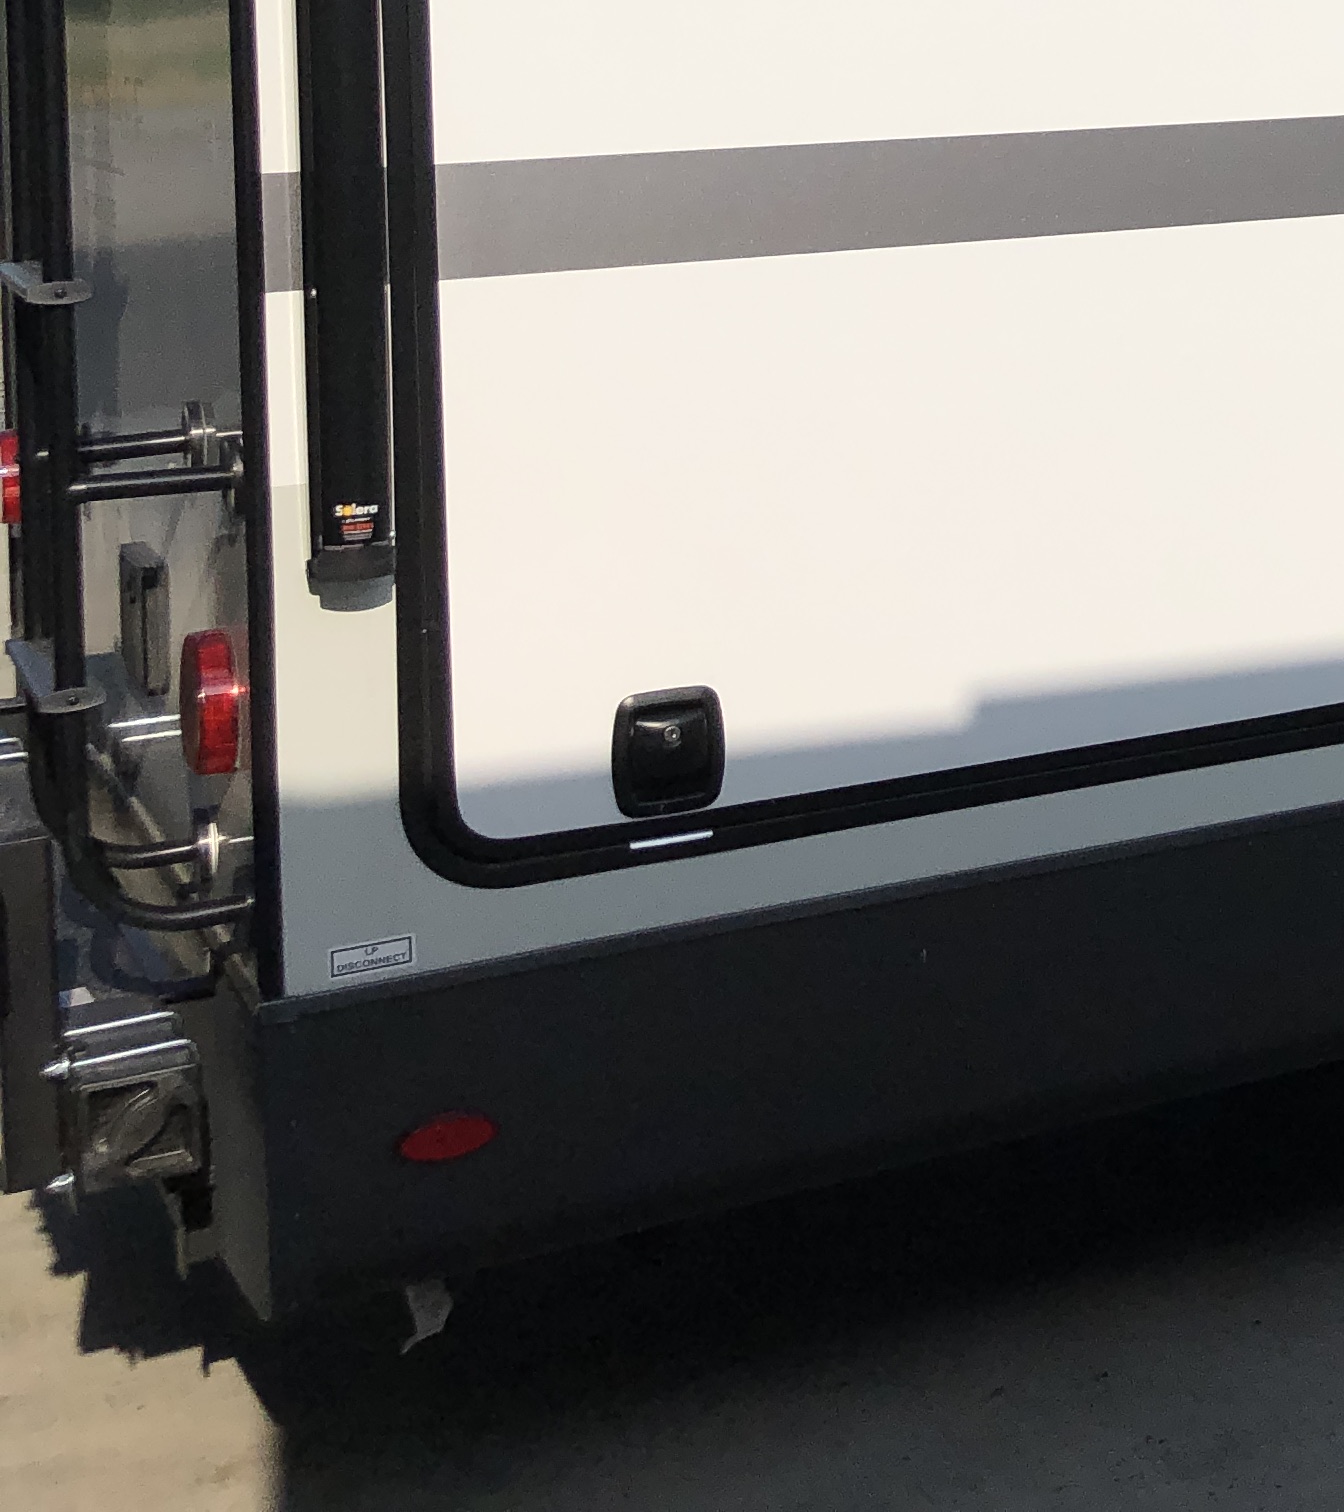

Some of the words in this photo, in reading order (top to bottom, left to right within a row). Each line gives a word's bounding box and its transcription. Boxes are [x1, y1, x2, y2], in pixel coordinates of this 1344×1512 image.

[334, 502, 380, 517] Solera
[364, 946, 379, 956] LP
[336, 951, 407, 973] DISCONNECT
